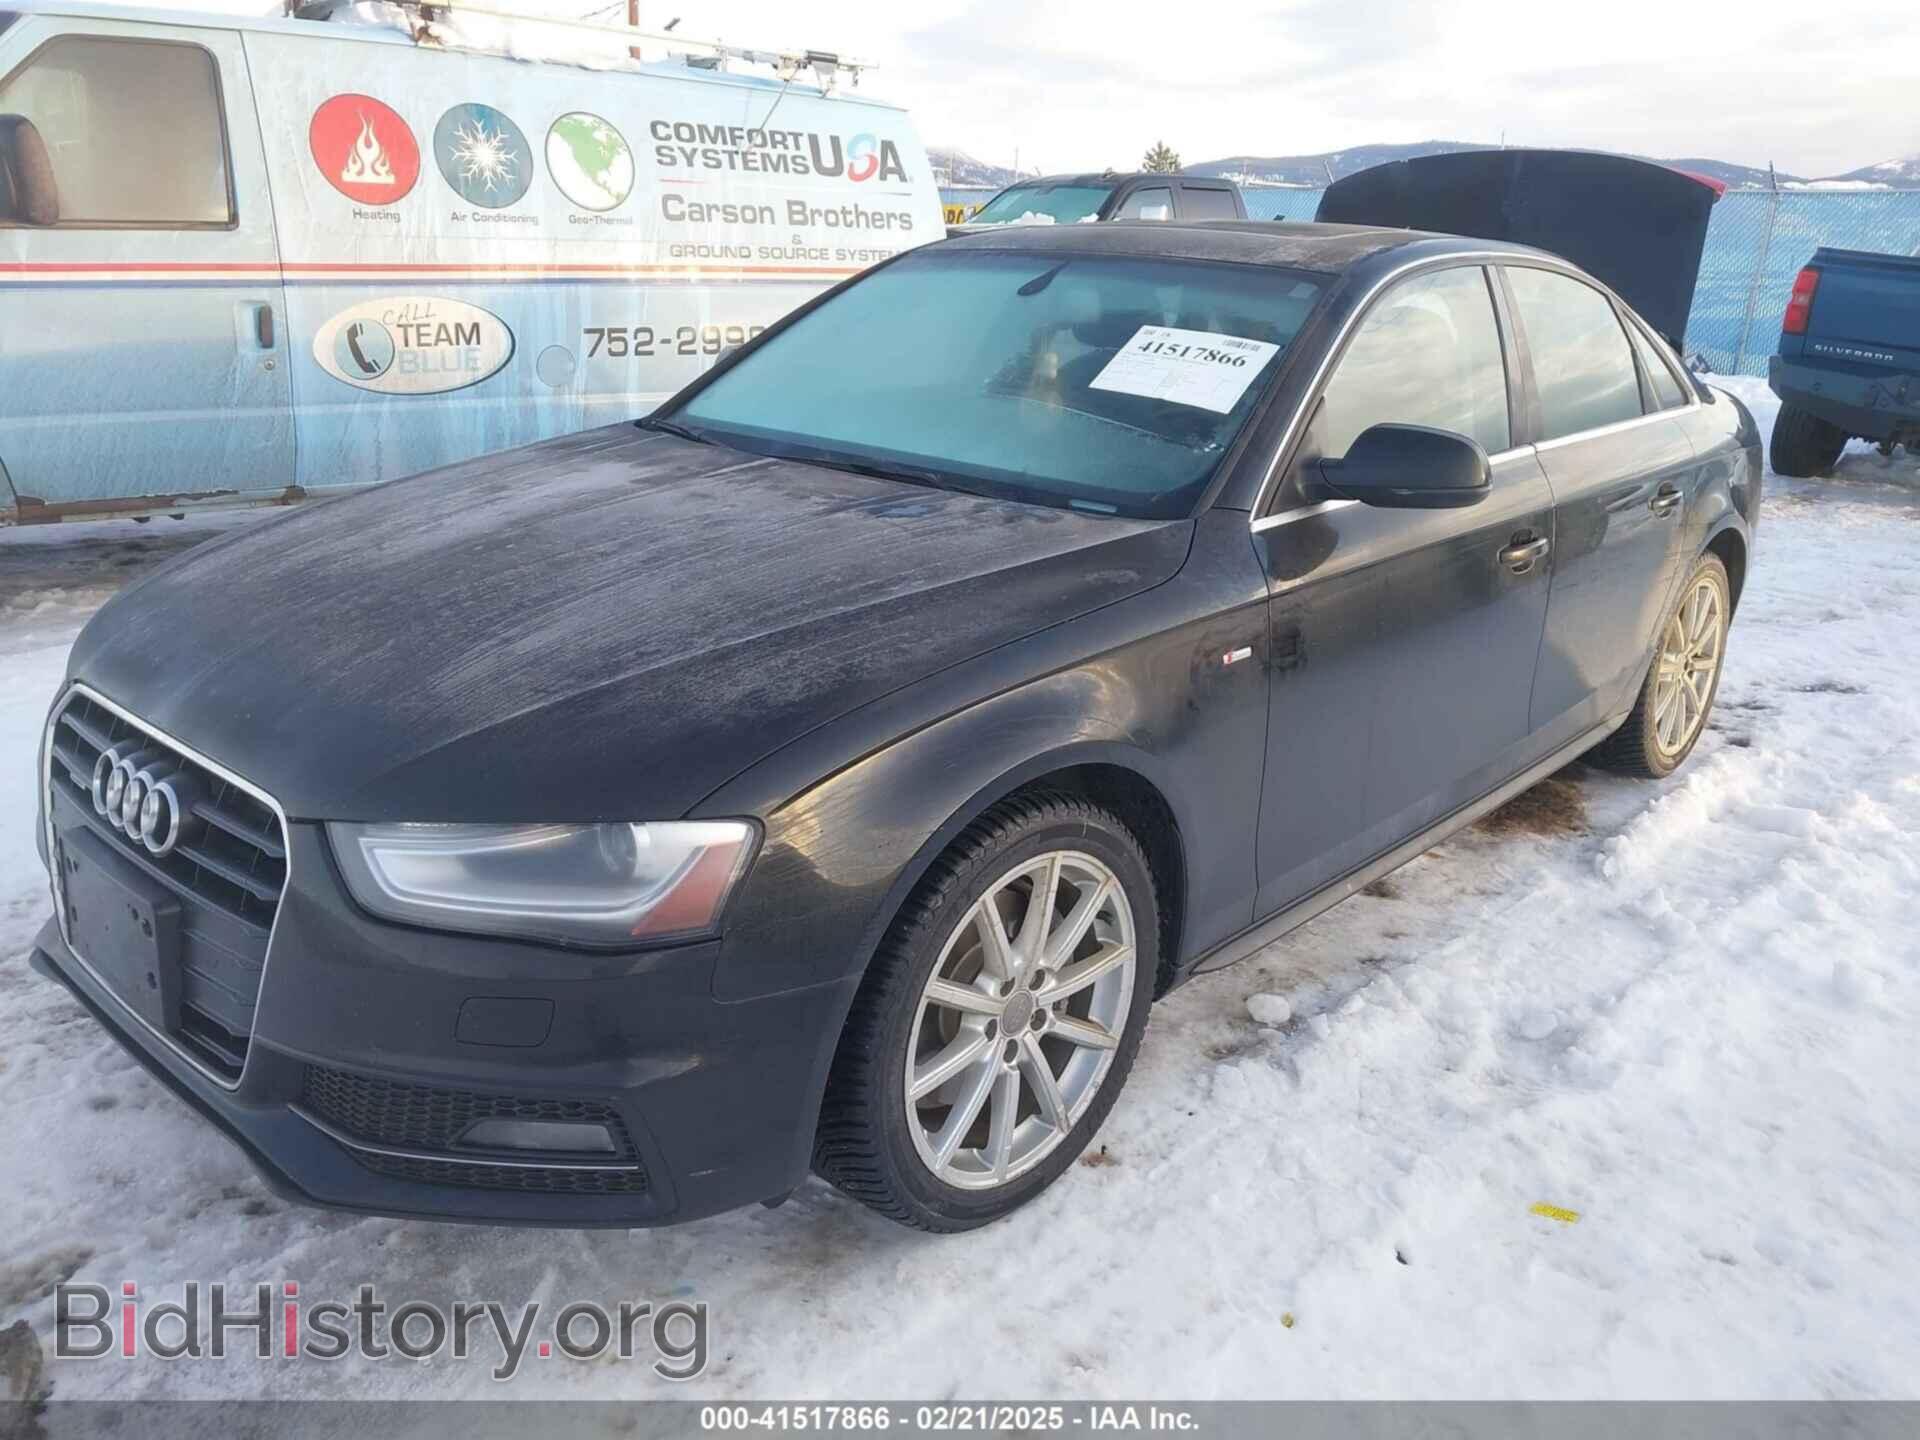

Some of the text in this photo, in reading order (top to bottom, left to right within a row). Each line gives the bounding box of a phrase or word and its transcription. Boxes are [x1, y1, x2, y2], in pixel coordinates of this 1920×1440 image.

[650, 119, 804, 151] COMFORT
[655, 145, 810, 175] SYSTEMS
[806, 132, 908, 183] USA
[352, 208, 401, 223] Heating
[450, 211, 540, 226] Air Conditioning
[661, 193, 776, 227] Carson
[786, 199, 913, 231] Brothers
[669, 245, 752, 259] GROUND
[758, 246, 830, 261] SOURCE
[396, 322, 481, 348] TEAM
[398, 349, 481, 374] BLUE
[1138, 340, 1247, 368] 41517866
